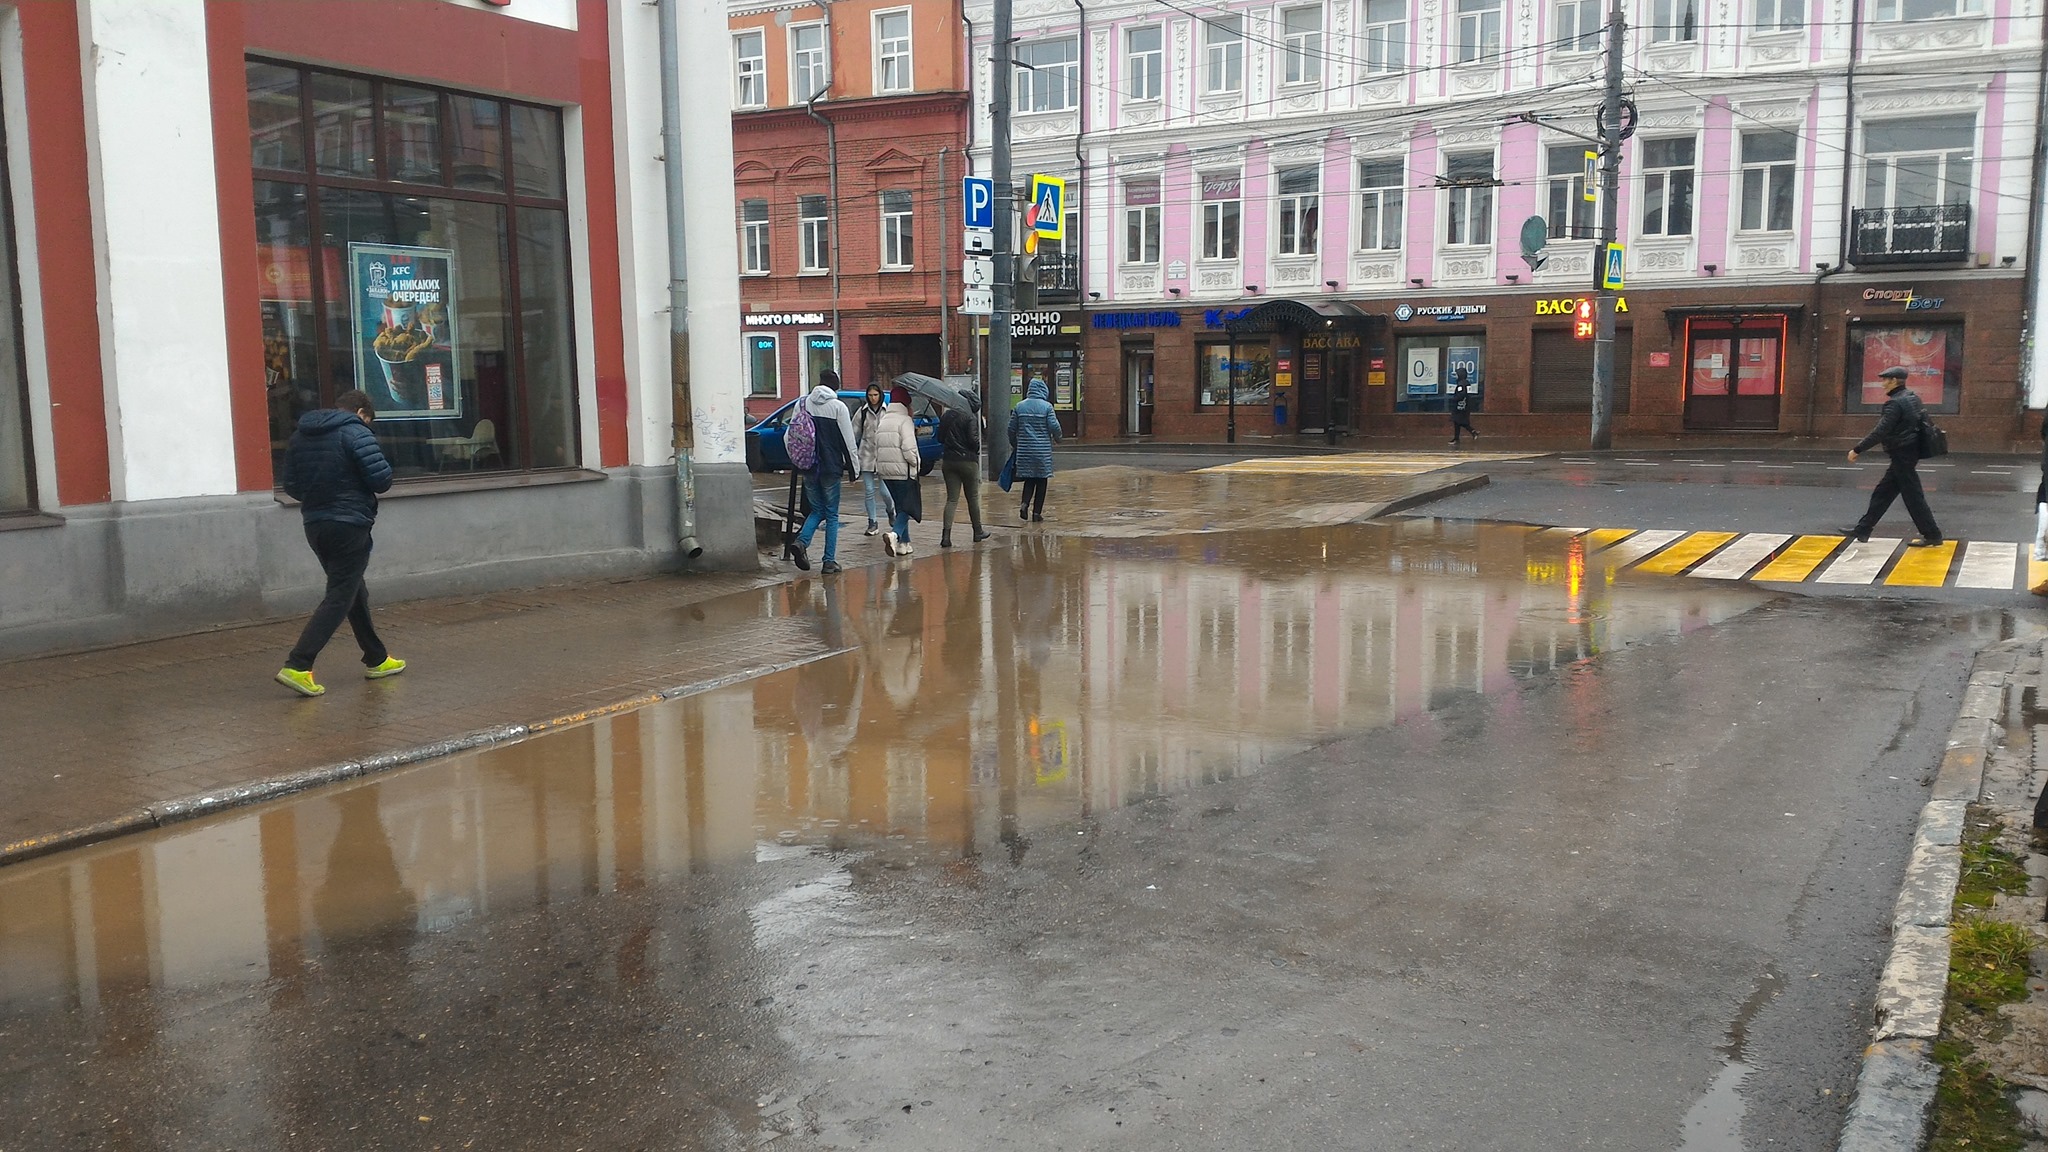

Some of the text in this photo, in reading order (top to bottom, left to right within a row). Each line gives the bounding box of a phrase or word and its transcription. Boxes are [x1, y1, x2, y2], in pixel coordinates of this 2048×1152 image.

[392, 266, 411, 276] KFC
[391, 279, 440, 290] И НИКАКИХ
[392, 289, 440, 304] ОЧЕРЕДЕЙ!
[1417, 305, 1486, 315] РУССКИЕ ДЕНЬГИ
[745, 313, 824, 325] МНОГО РЫБЫ
[1011, 311, 1061, 324] РОЧНО
[1092, 311, 1181, 329] НЕМЕЦКАЯ ОБУВЬ
[1578, 322, 1592, 336] 34
